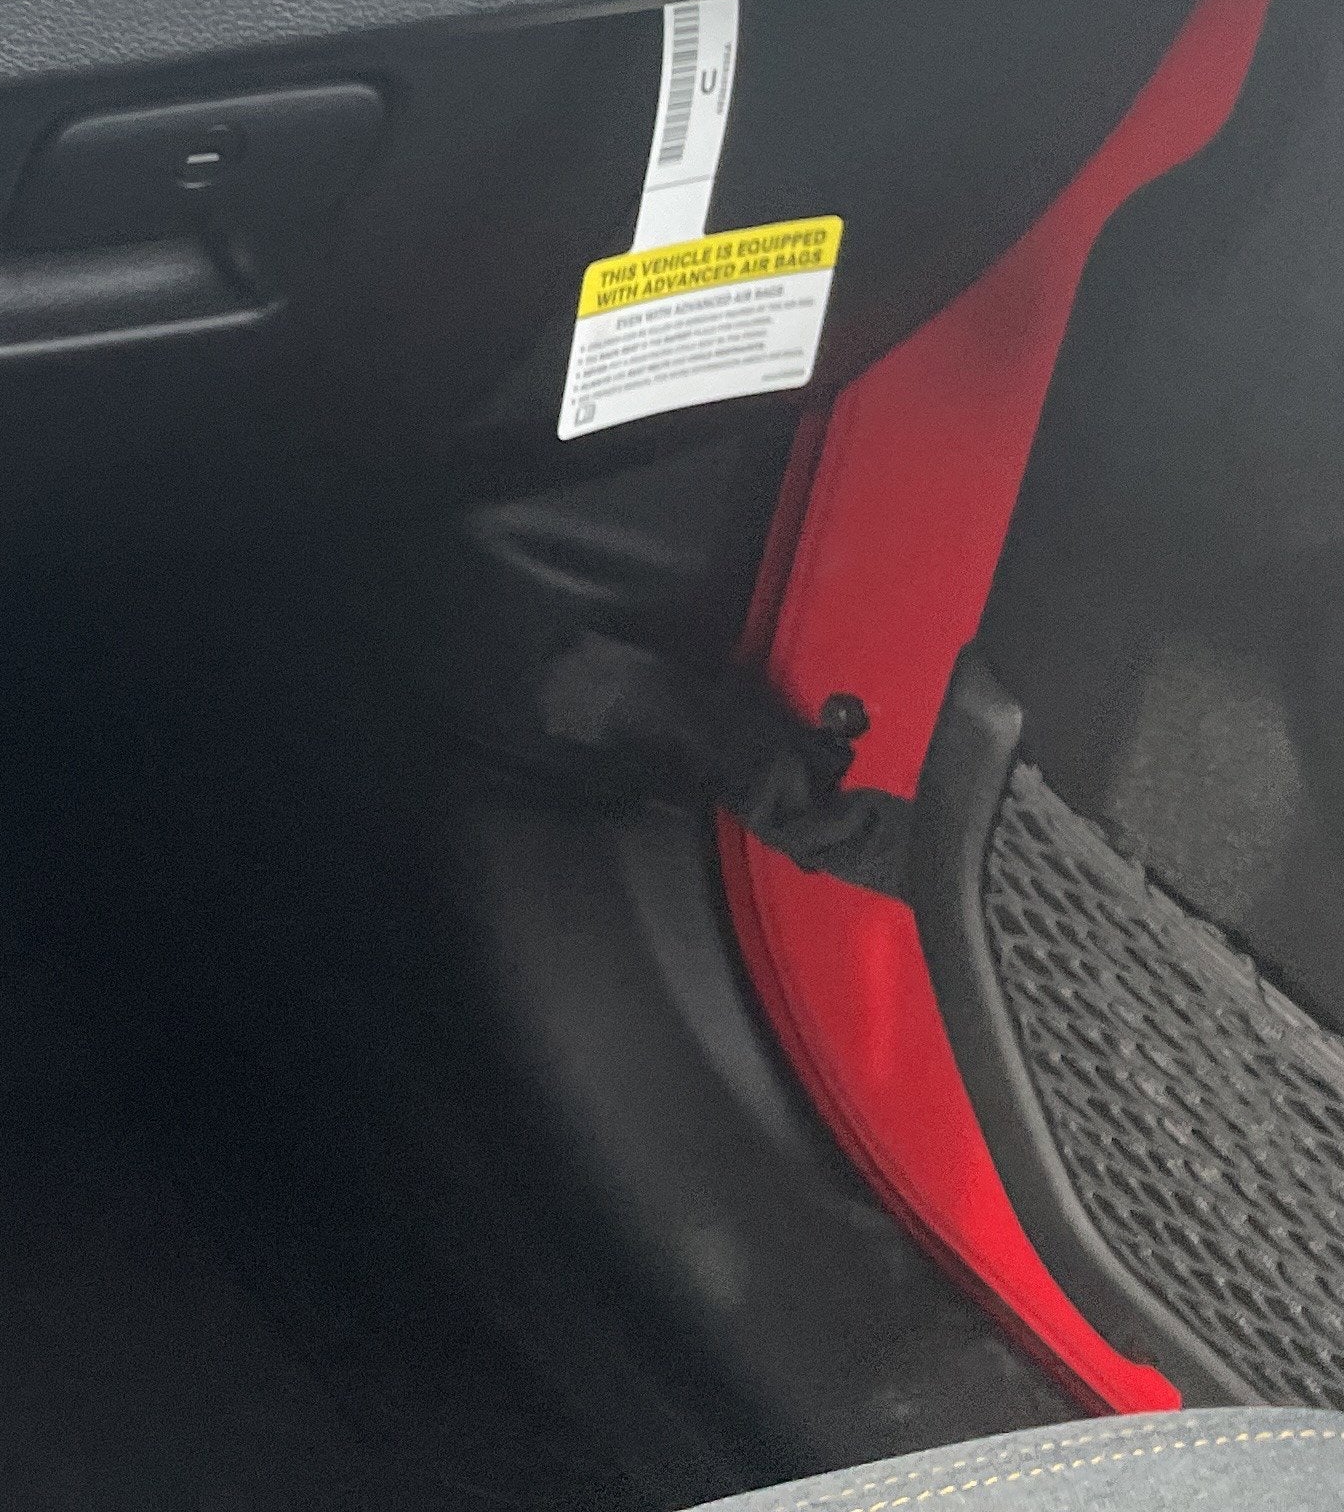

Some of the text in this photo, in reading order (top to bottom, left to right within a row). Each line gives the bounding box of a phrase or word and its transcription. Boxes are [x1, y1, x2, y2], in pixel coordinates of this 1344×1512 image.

[596, 248, 823, 307] WITH ADVANCED AIR BAGS
[600, 229, 827, 289] THIS VEHICLE IS EQUIPPED
